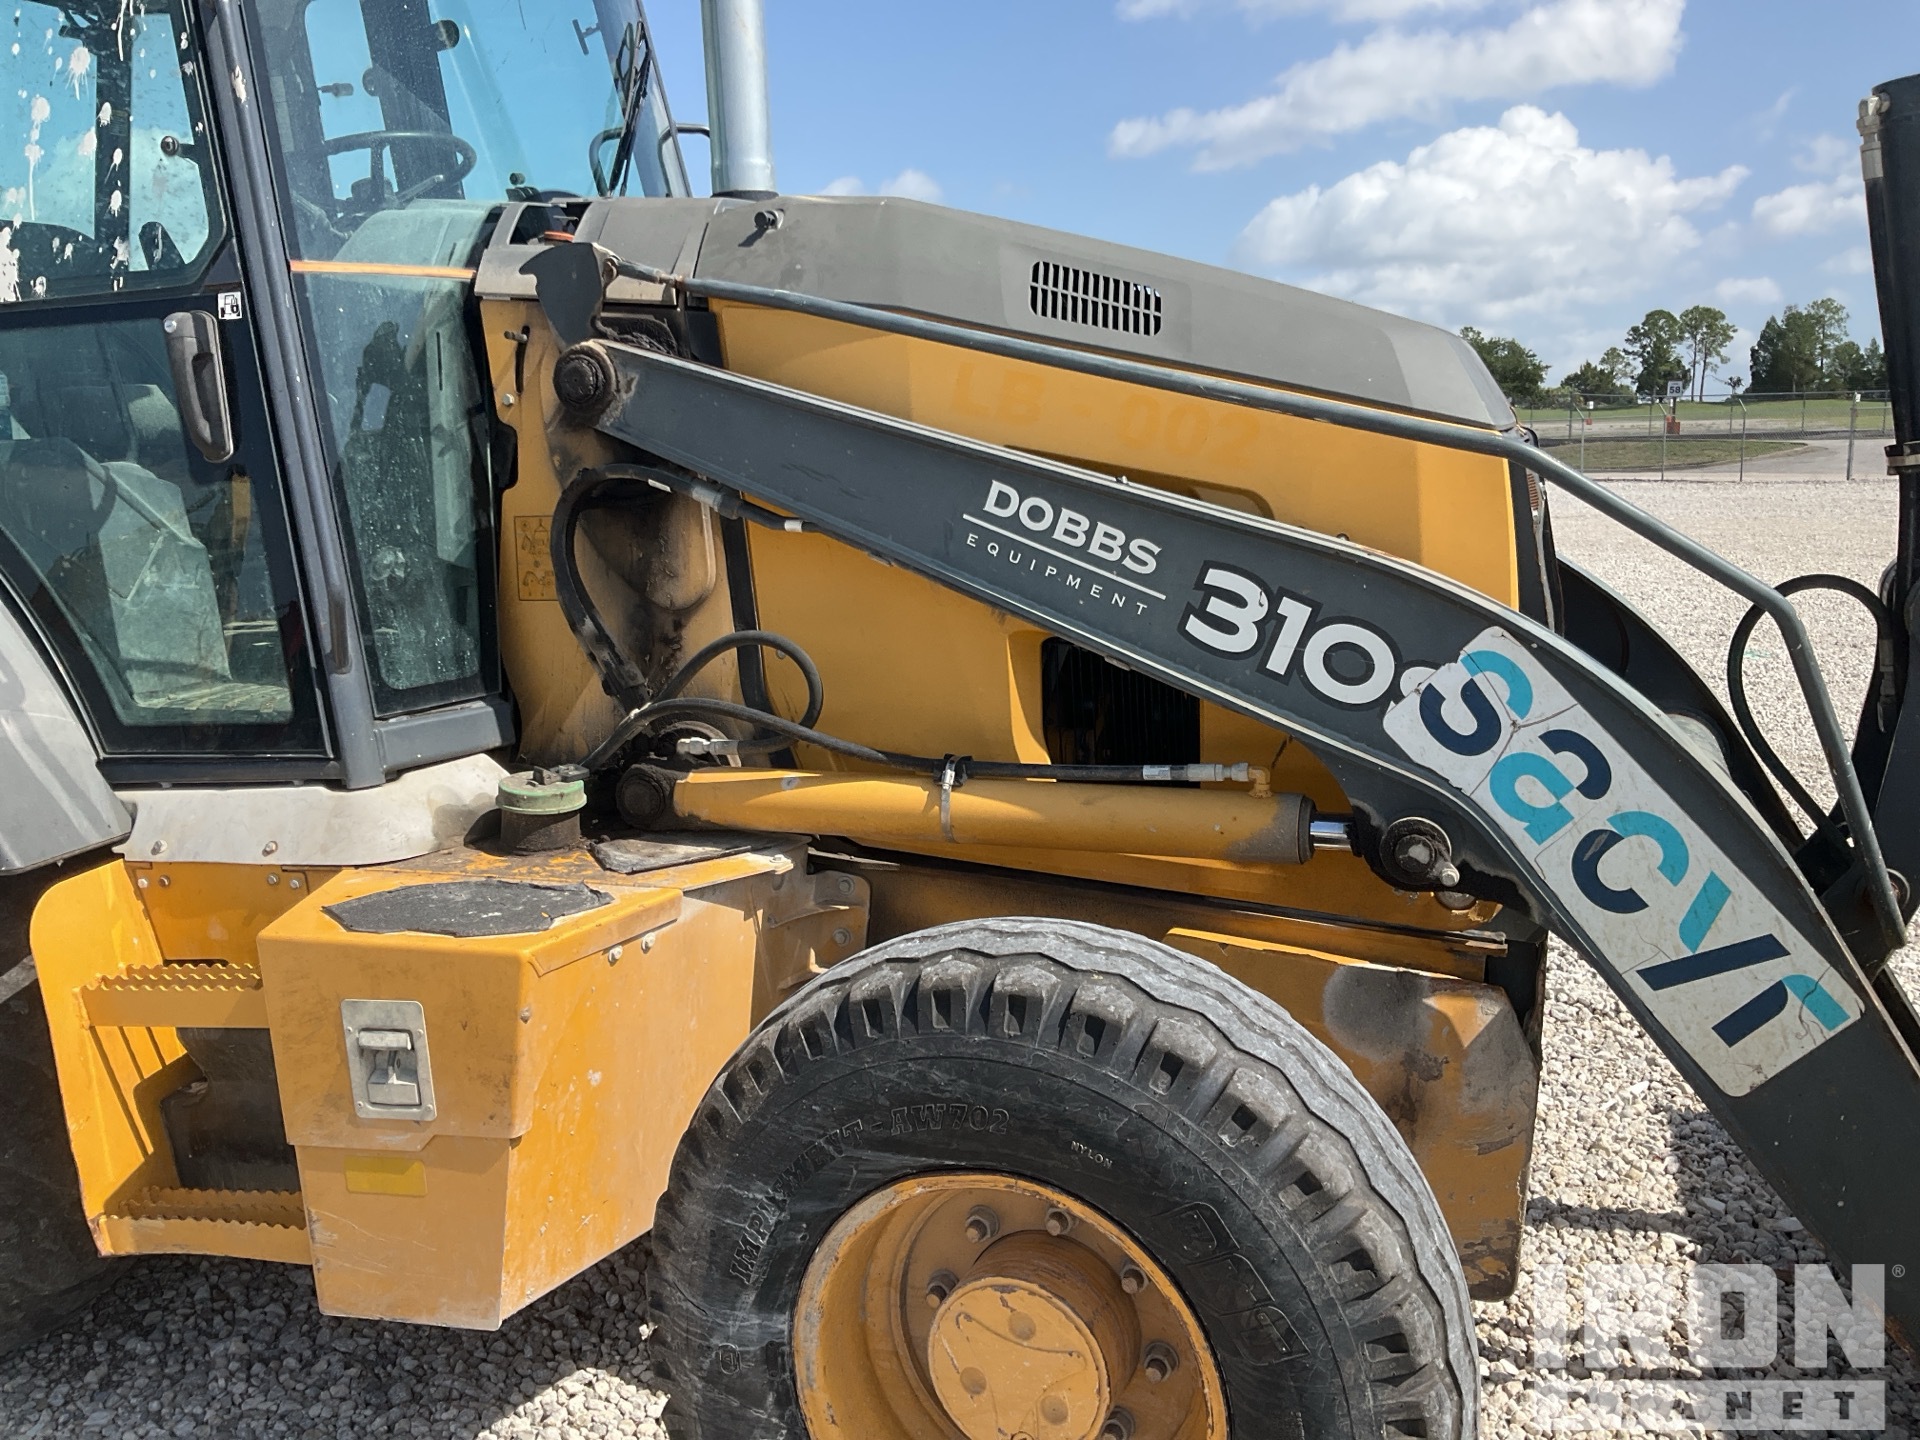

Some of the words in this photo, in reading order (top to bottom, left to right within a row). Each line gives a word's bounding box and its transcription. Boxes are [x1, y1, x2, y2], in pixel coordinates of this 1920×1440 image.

[1115, 393, 1259, 468] 002
[982, 480, 1162, 574] DOBBS
[966, 533, 1147, 615] EQUIPMENT
[1186, 568, 1437, 706] 310
[1070, 1140, 1113, 1168] NYLON
